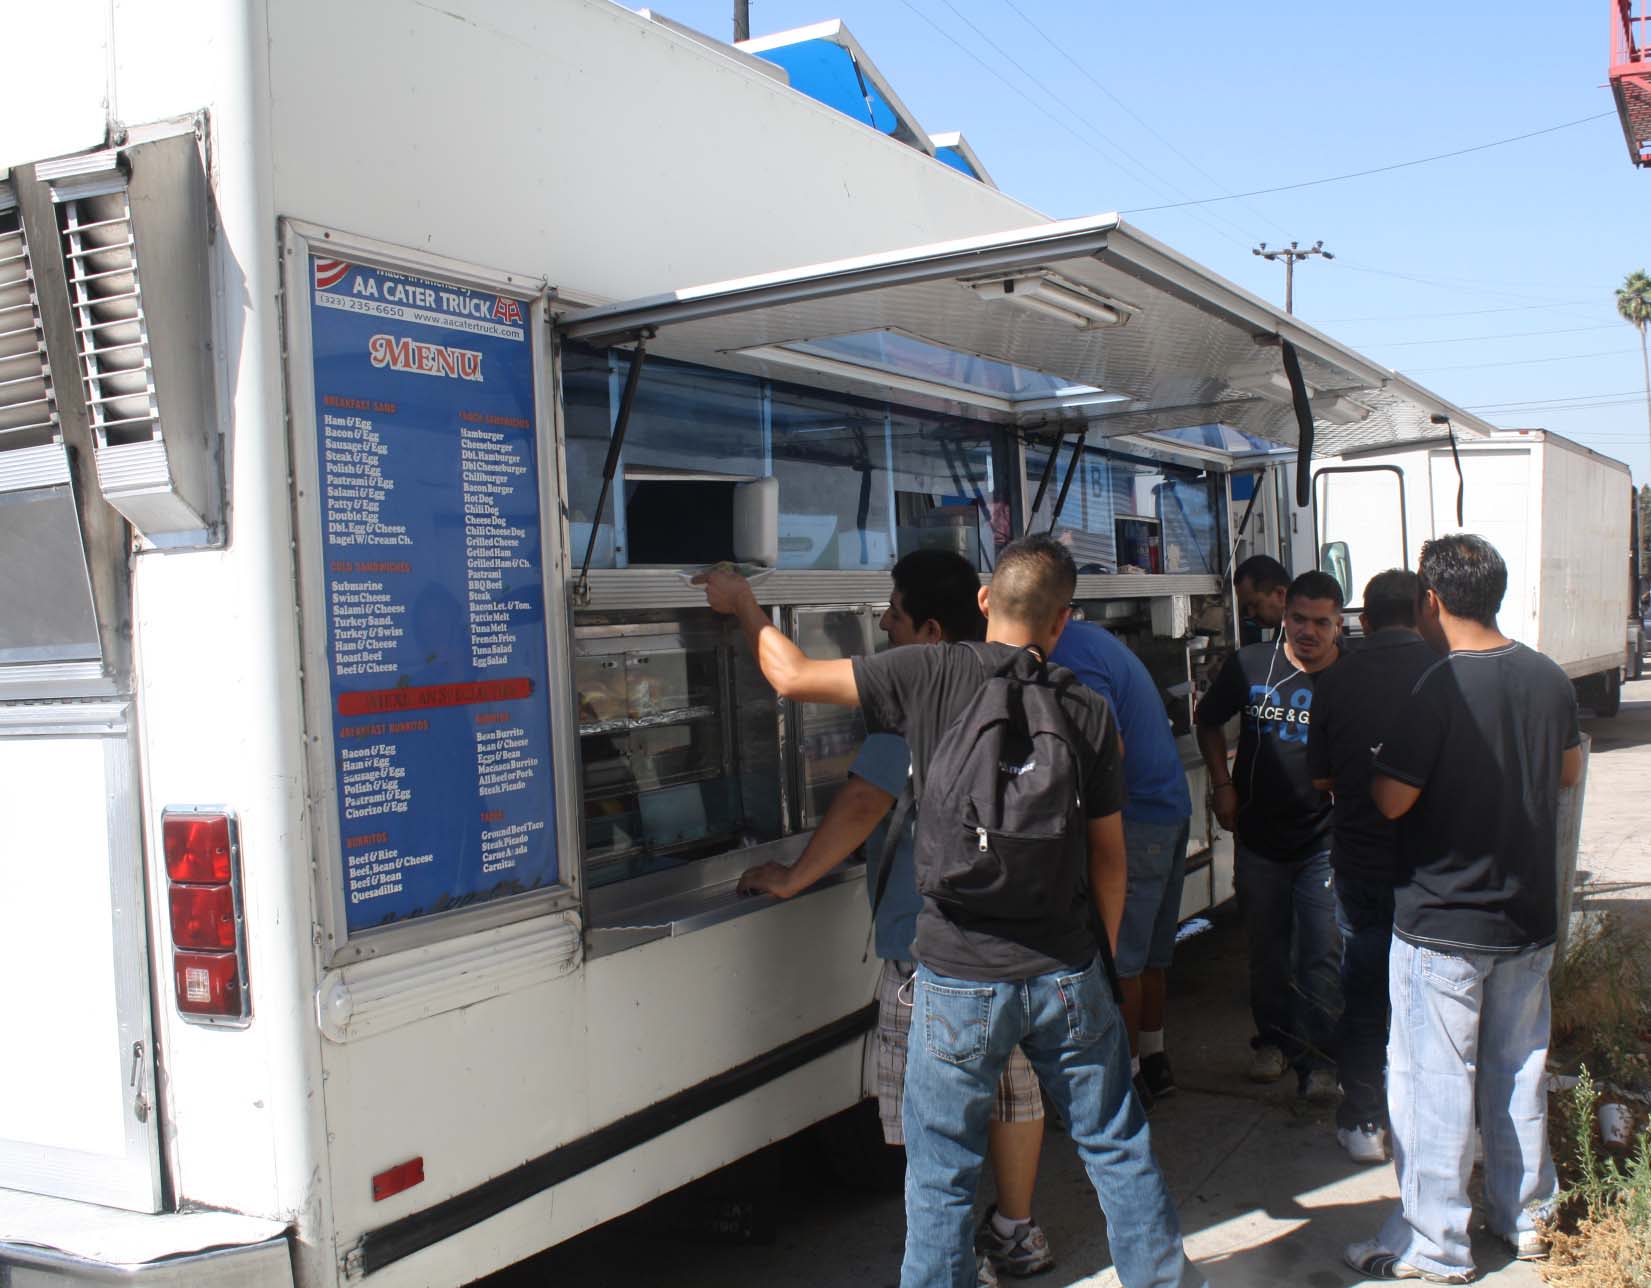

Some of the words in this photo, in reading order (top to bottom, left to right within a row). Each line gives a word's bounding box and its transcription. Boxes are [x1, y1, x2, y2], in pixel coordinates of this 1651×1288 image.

[321, 295, 345, 307] (323)
[350, 300, 404, 317] 235-6650
[414, 314, 520, 338] www.aacatertruck.com
[353, 276, 379, 297] AA
[383, 281, 436, 308] CATER
[440, 292, 491, 318] TRUCK
[369, 334, 484, 382] MENU
[1287, 709, 1295, 721] &
[1299, 711, 1310, 724] G
